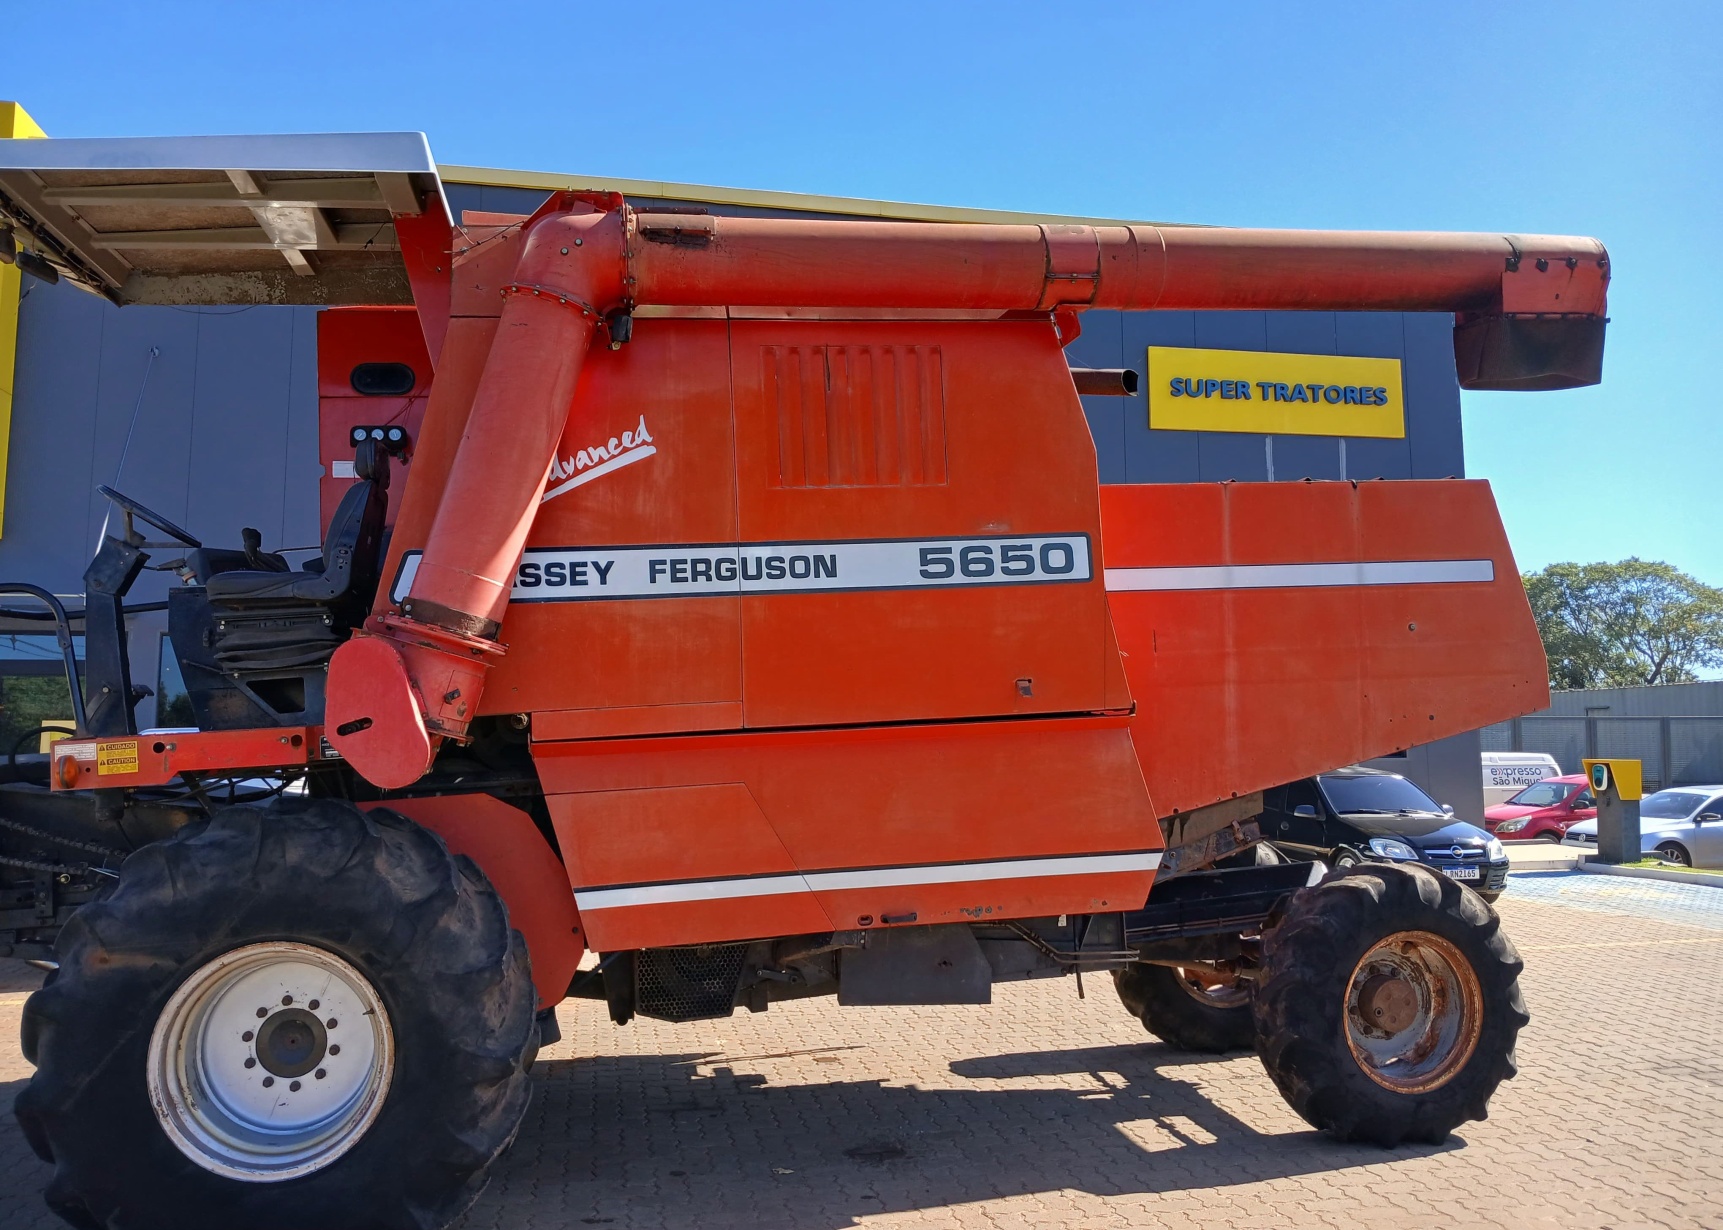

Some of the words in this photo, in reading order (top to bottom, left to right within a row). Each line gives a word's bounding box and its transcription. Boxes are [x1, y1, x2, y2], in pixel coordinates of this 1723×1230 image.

[1170, 377, 1252, 400] SUPER
[1256, 382, 1388, 407] TRATORES
[548, 414, 653, 481] dvanced
[512, 560, 615, 588] SSEY
[648, 554, 837, 584] FERGUSON
[919, 542, 1074, 579] 5650
[1490, 767, 1542, 778] expresso
[1492, 776, 1511, 785] São
